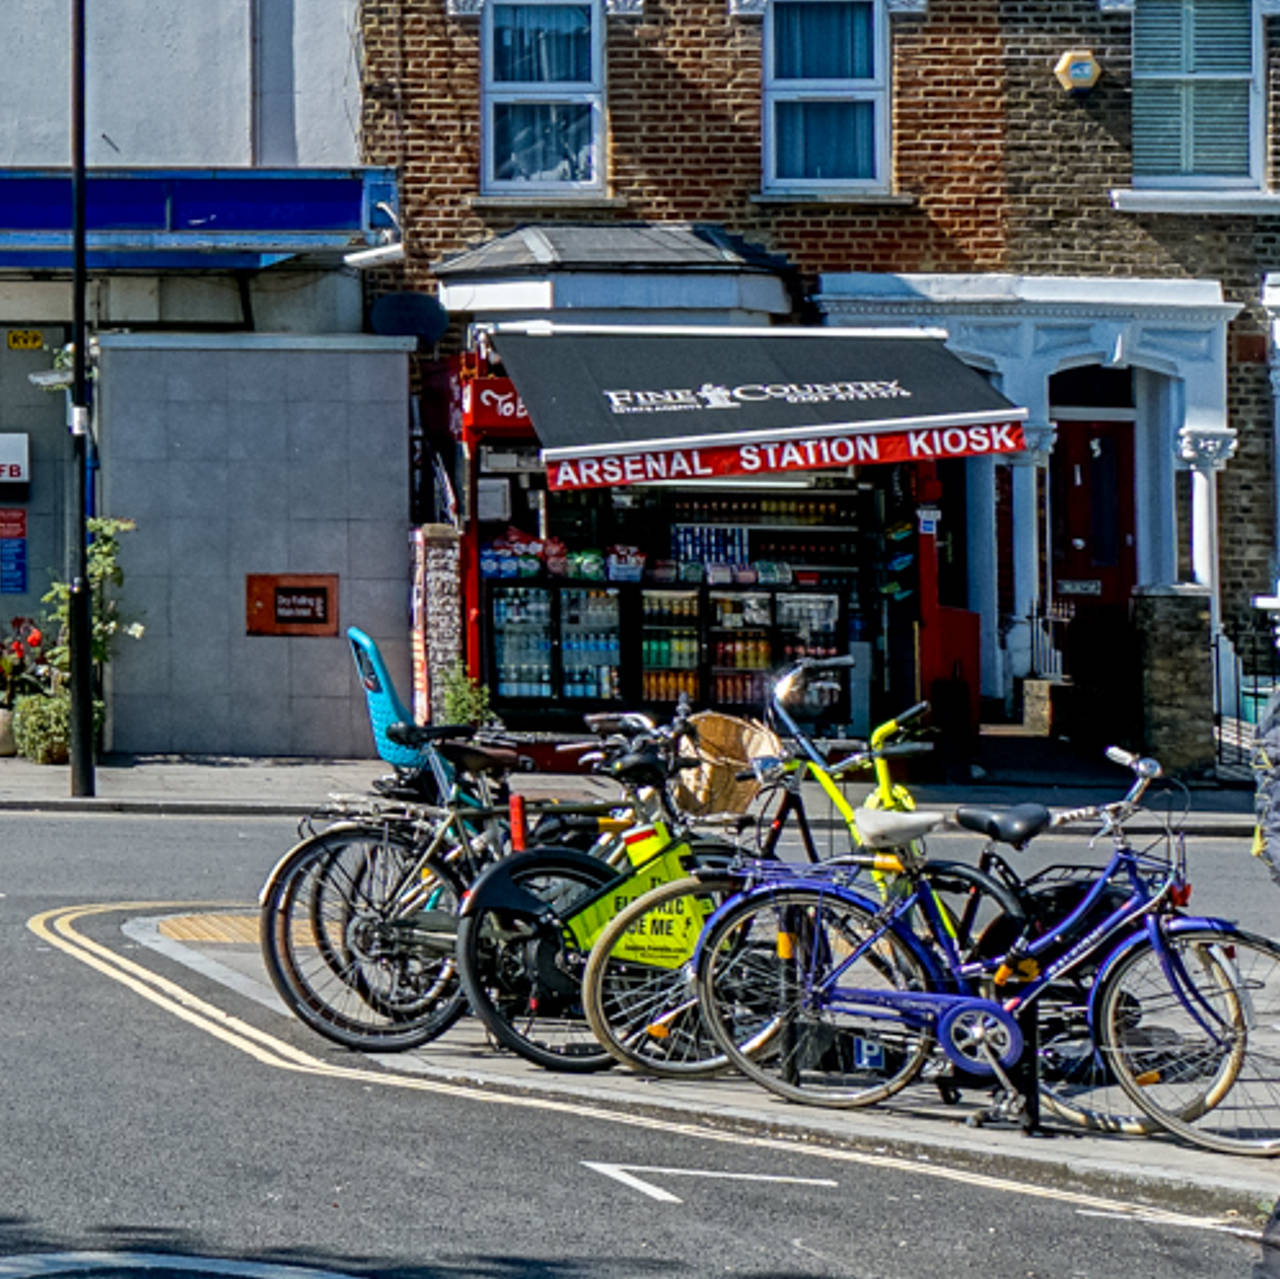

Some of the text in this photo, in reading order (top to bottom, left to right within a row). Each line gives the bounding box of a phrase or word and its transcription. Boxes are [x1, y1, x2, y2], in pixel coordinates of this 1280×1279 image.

[603, 388, 698, 406] FINE
[557, 423, 1017, 487] ARSENAL STATION KIOSK
[650, 919, 674, 936] ME
